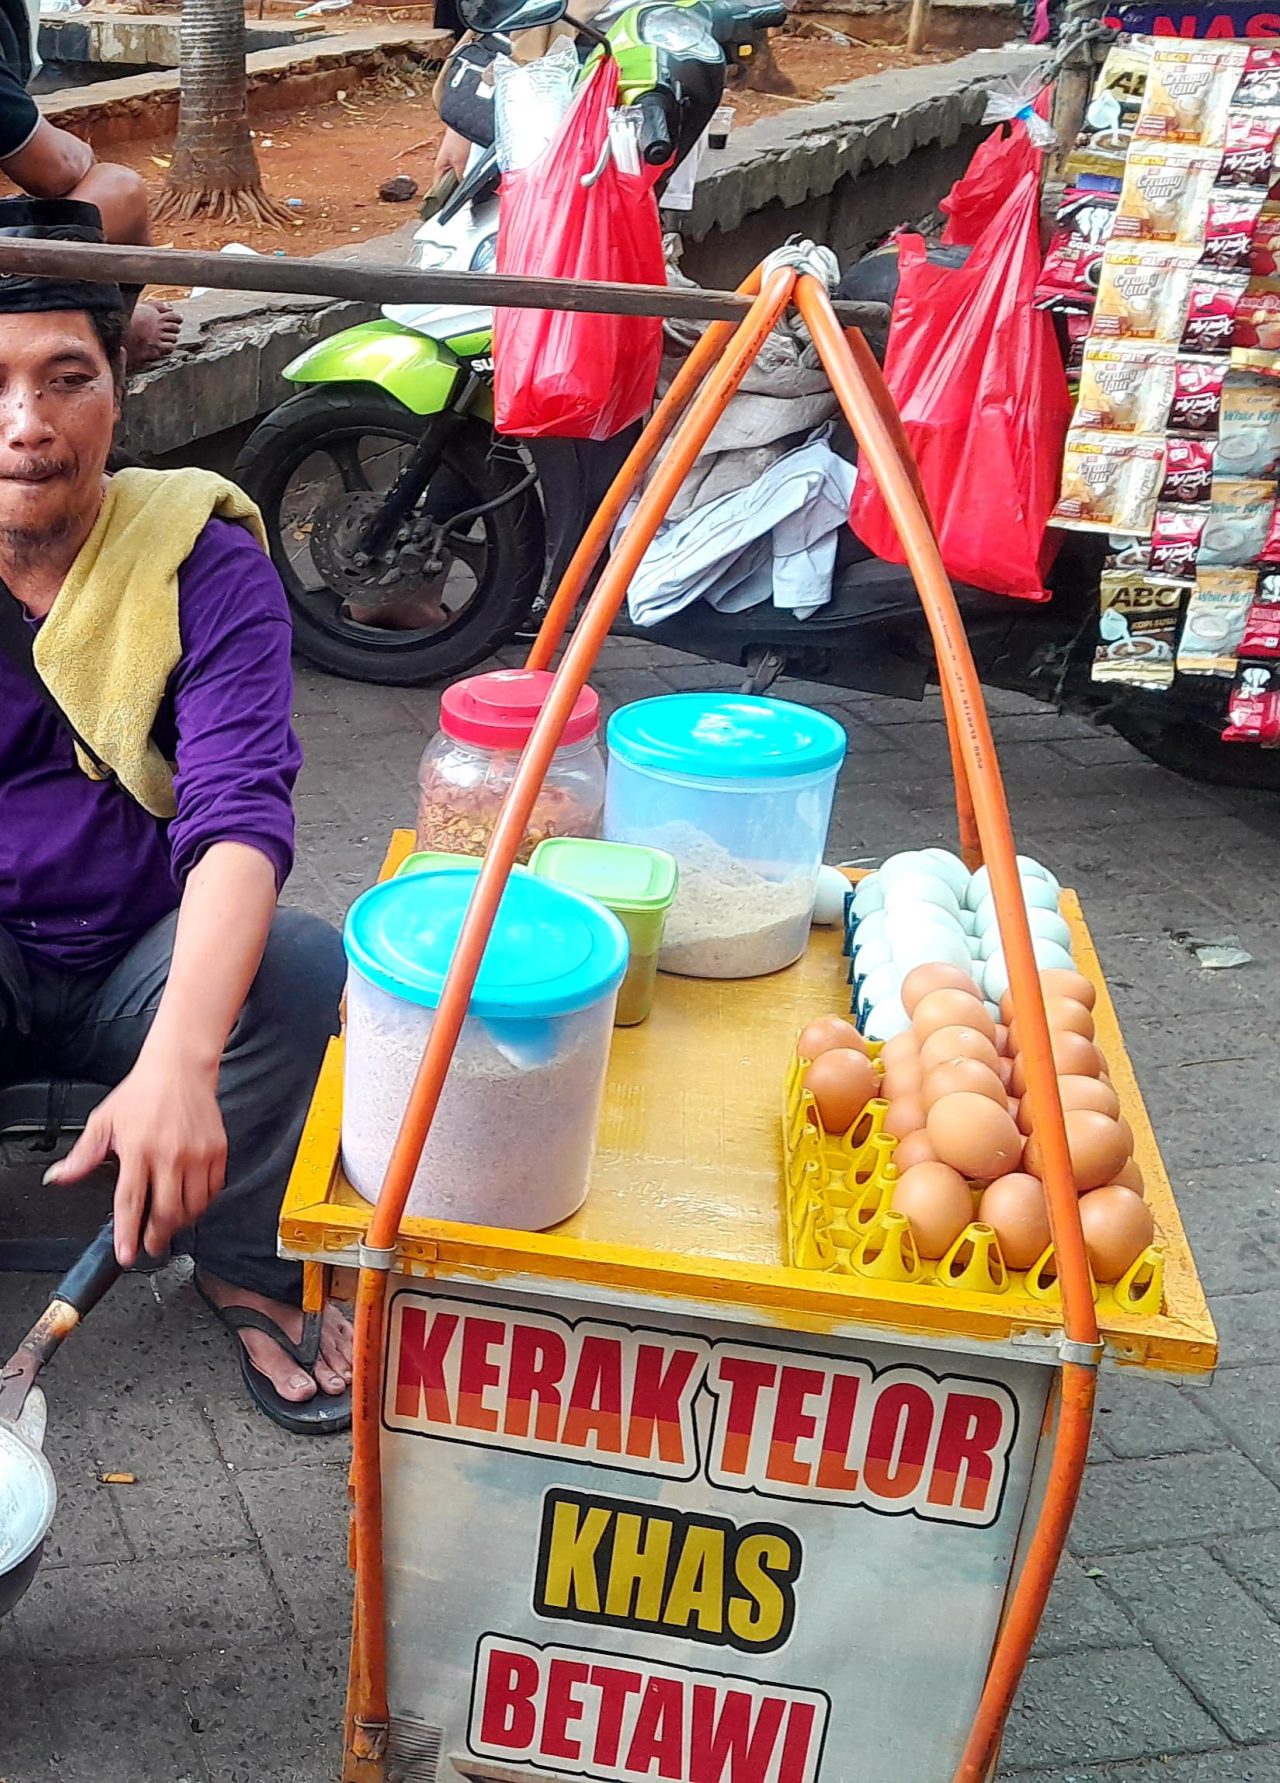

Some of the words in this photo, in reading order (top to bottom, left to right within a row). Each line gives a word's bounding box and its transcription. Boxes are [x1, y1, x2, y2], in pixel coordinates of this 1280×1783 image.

[1107, 587, 1177, 608] ABC
[394, 1306, 706, 1467] KERAK
[719, 1357, 1004, 1512] TELOR
[542, 1500, 792, 1643] KHAS
[479, 1648, 816, 1783] BETAWI
